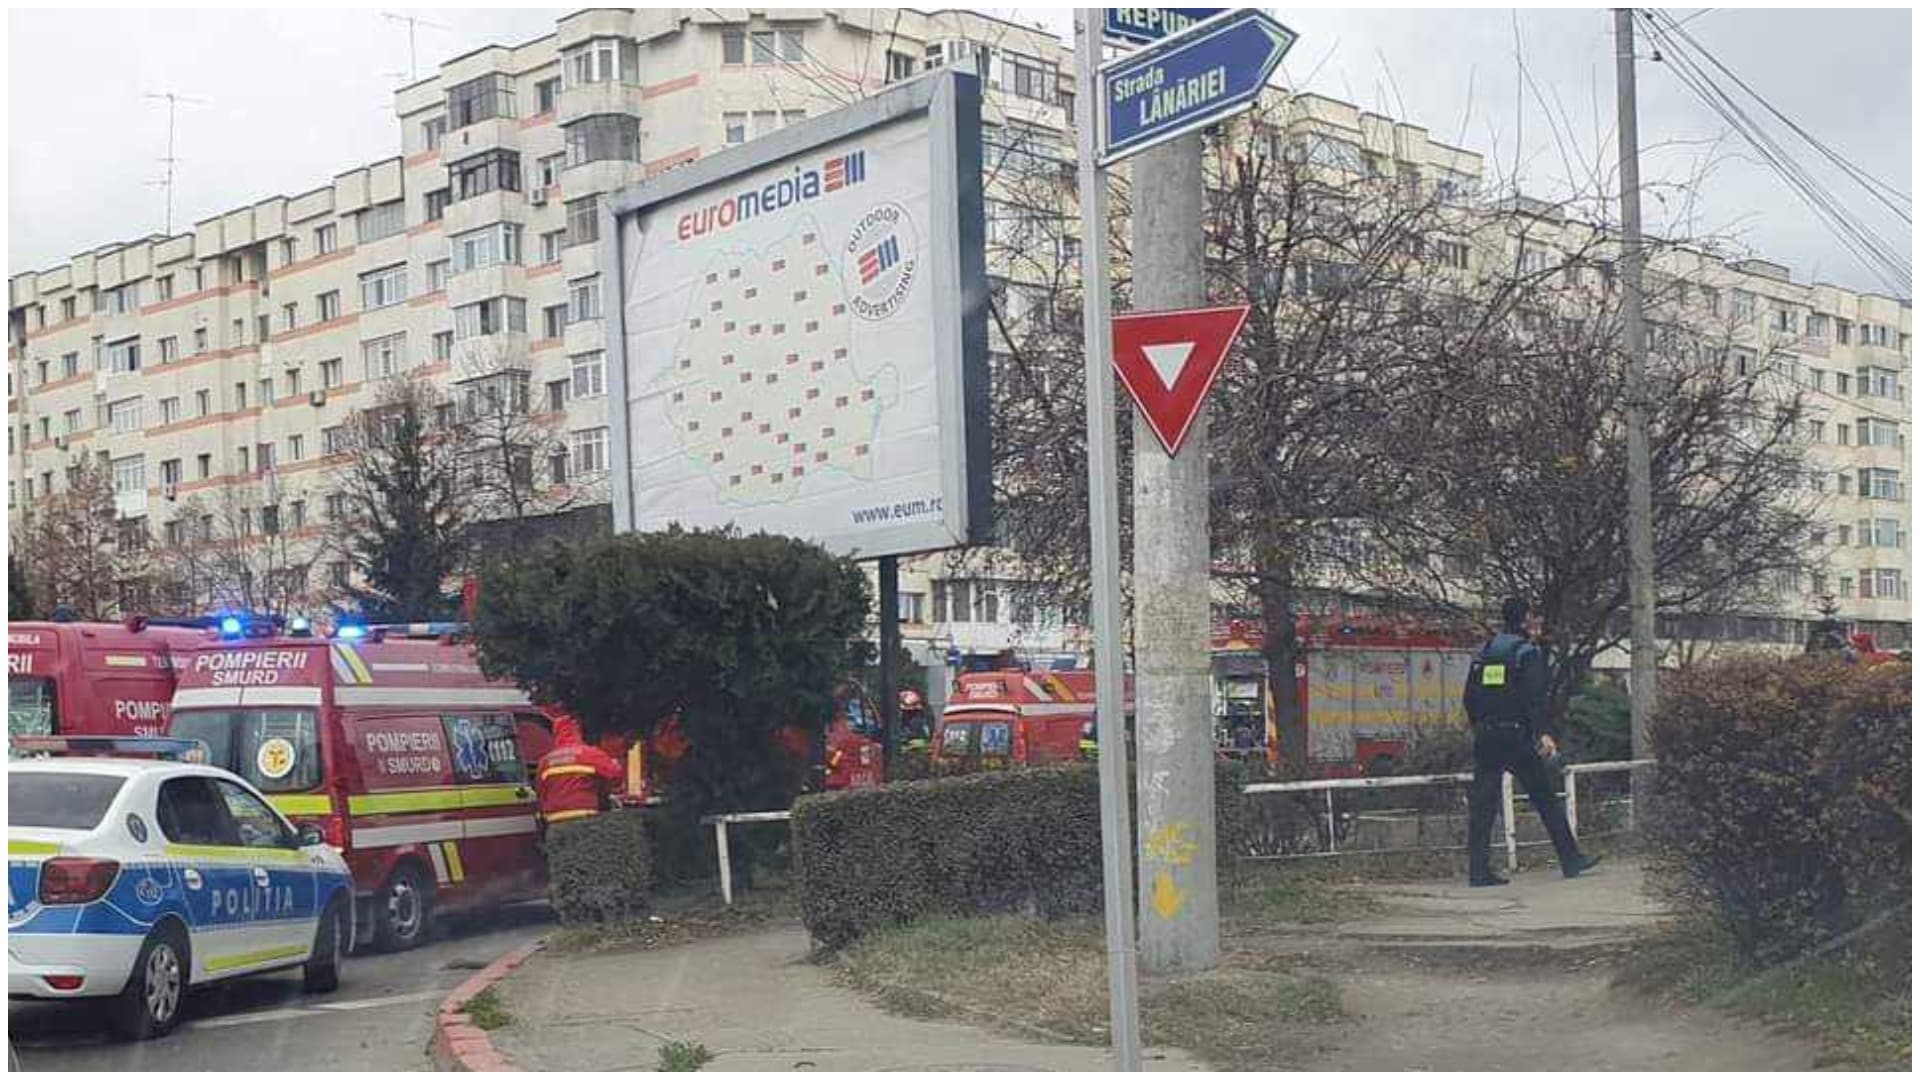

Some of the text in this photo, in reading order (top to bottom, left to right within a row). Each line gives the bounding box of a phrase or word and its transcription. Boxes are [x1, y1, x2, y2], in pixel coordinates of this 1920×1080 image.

[1115, 65, 1164, 102] Strada
[848, 207, 901, 254] OUTDOOR
[852, 259, 915, 317] ADVERTISING
[195, 651, 309, 672] POMPIERII
[212, 670, 279, 686] SMURD
[365, 731, 442, 753] POMPIERII
